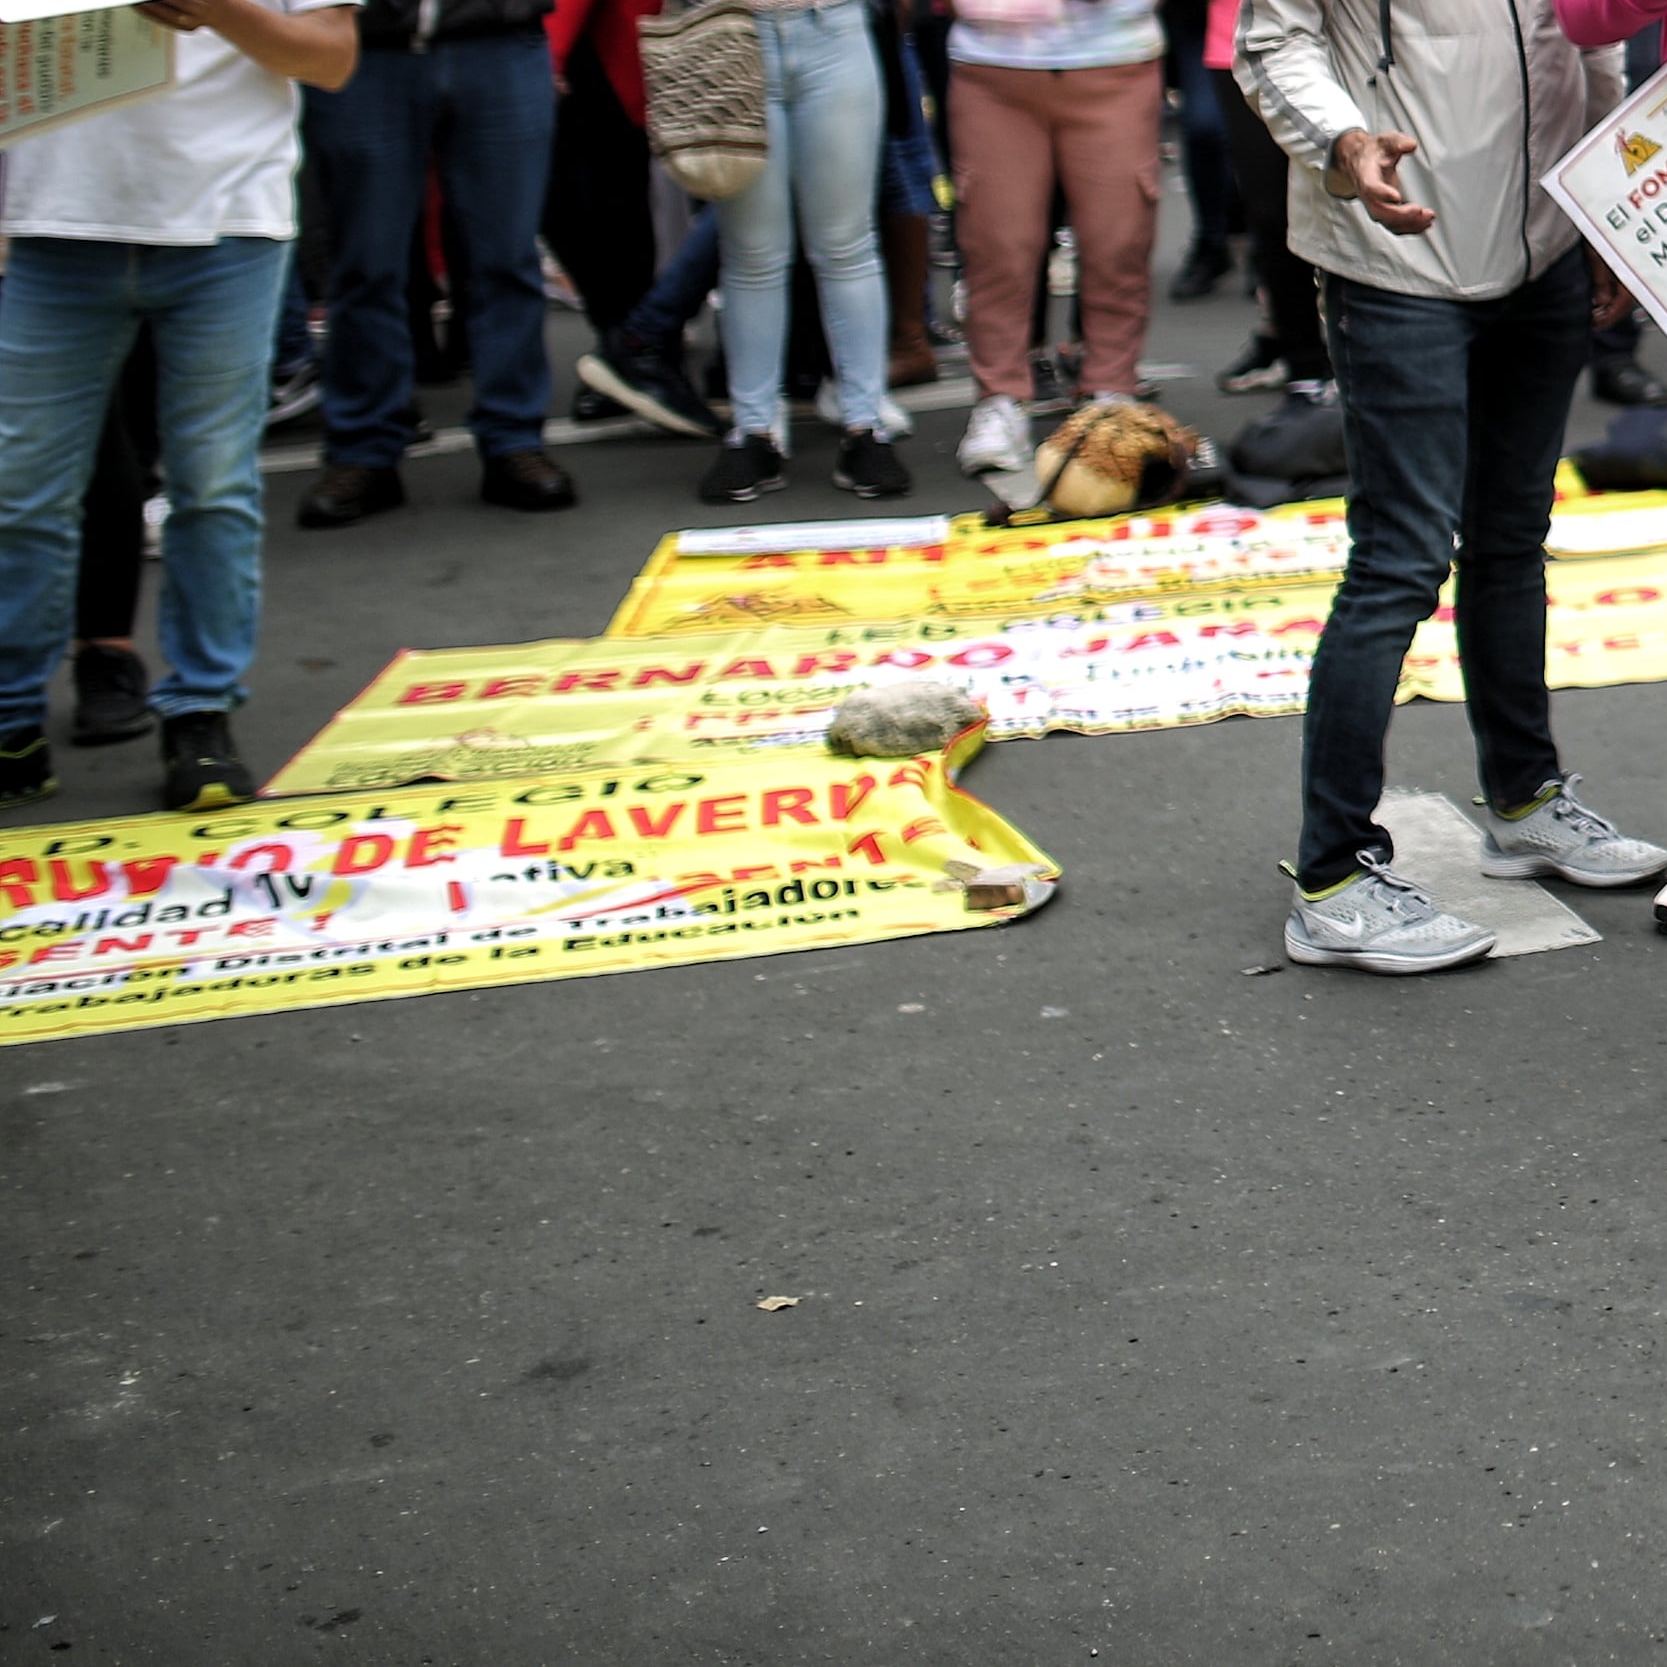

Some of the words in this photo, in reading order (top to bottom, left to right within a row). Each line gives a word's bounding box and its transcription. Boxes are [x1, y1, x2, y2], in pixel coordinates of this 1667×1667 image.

[1606, 207, 1631, 232] El
[1635, 218, 1657, 244] el
[395, 644, 1015, 707] BERNARDO
[189, 772, 705, 842] COLEGIO
[332, 824, 464, 877] DE
[214, 932, 450, 972] Distrital
[470, 924, 539, 943] de
[398, 951, 469, 970] de
[489, 943, 541, 961] la
